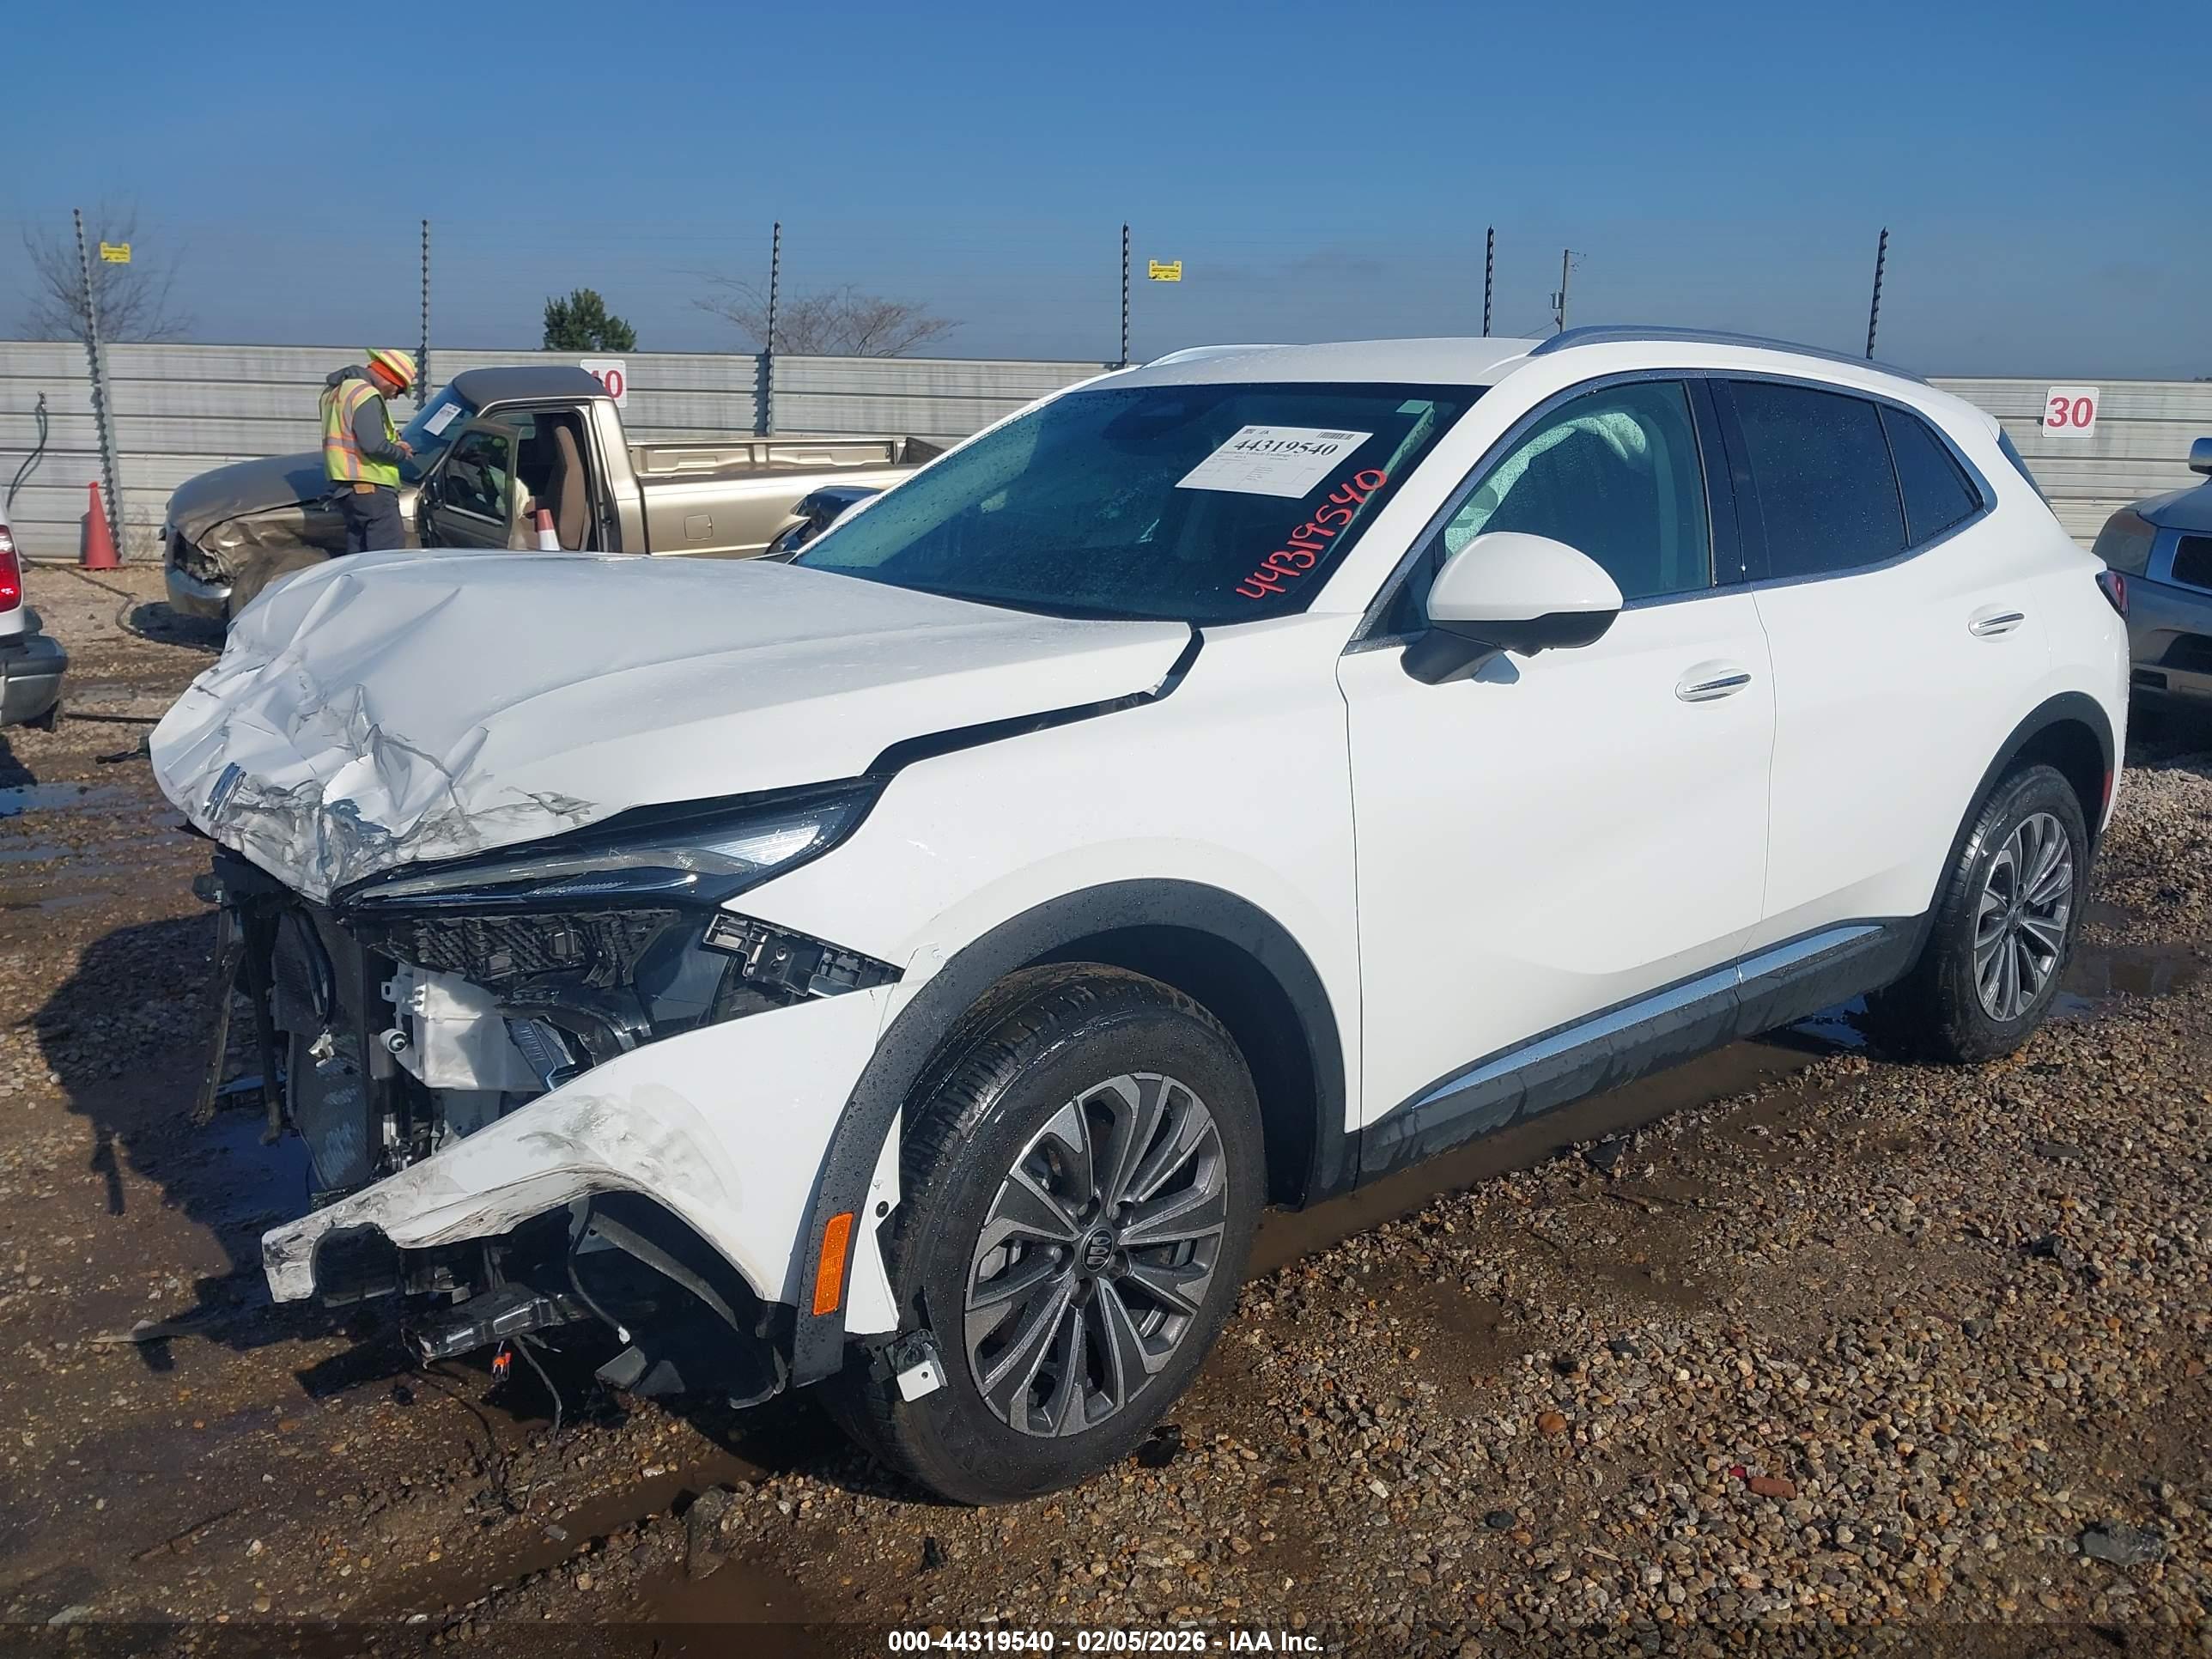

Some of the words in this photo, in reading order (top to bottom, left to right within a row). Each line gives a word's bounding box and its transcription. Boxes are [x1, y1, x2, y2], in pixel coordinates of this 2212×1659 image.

[591, 369, 623, 399] 0
[2046, 397, 2094, 428] 30
[1234, 439, 1340, 457] 44319540
[1236, 470, 1388, 599] 44319540
